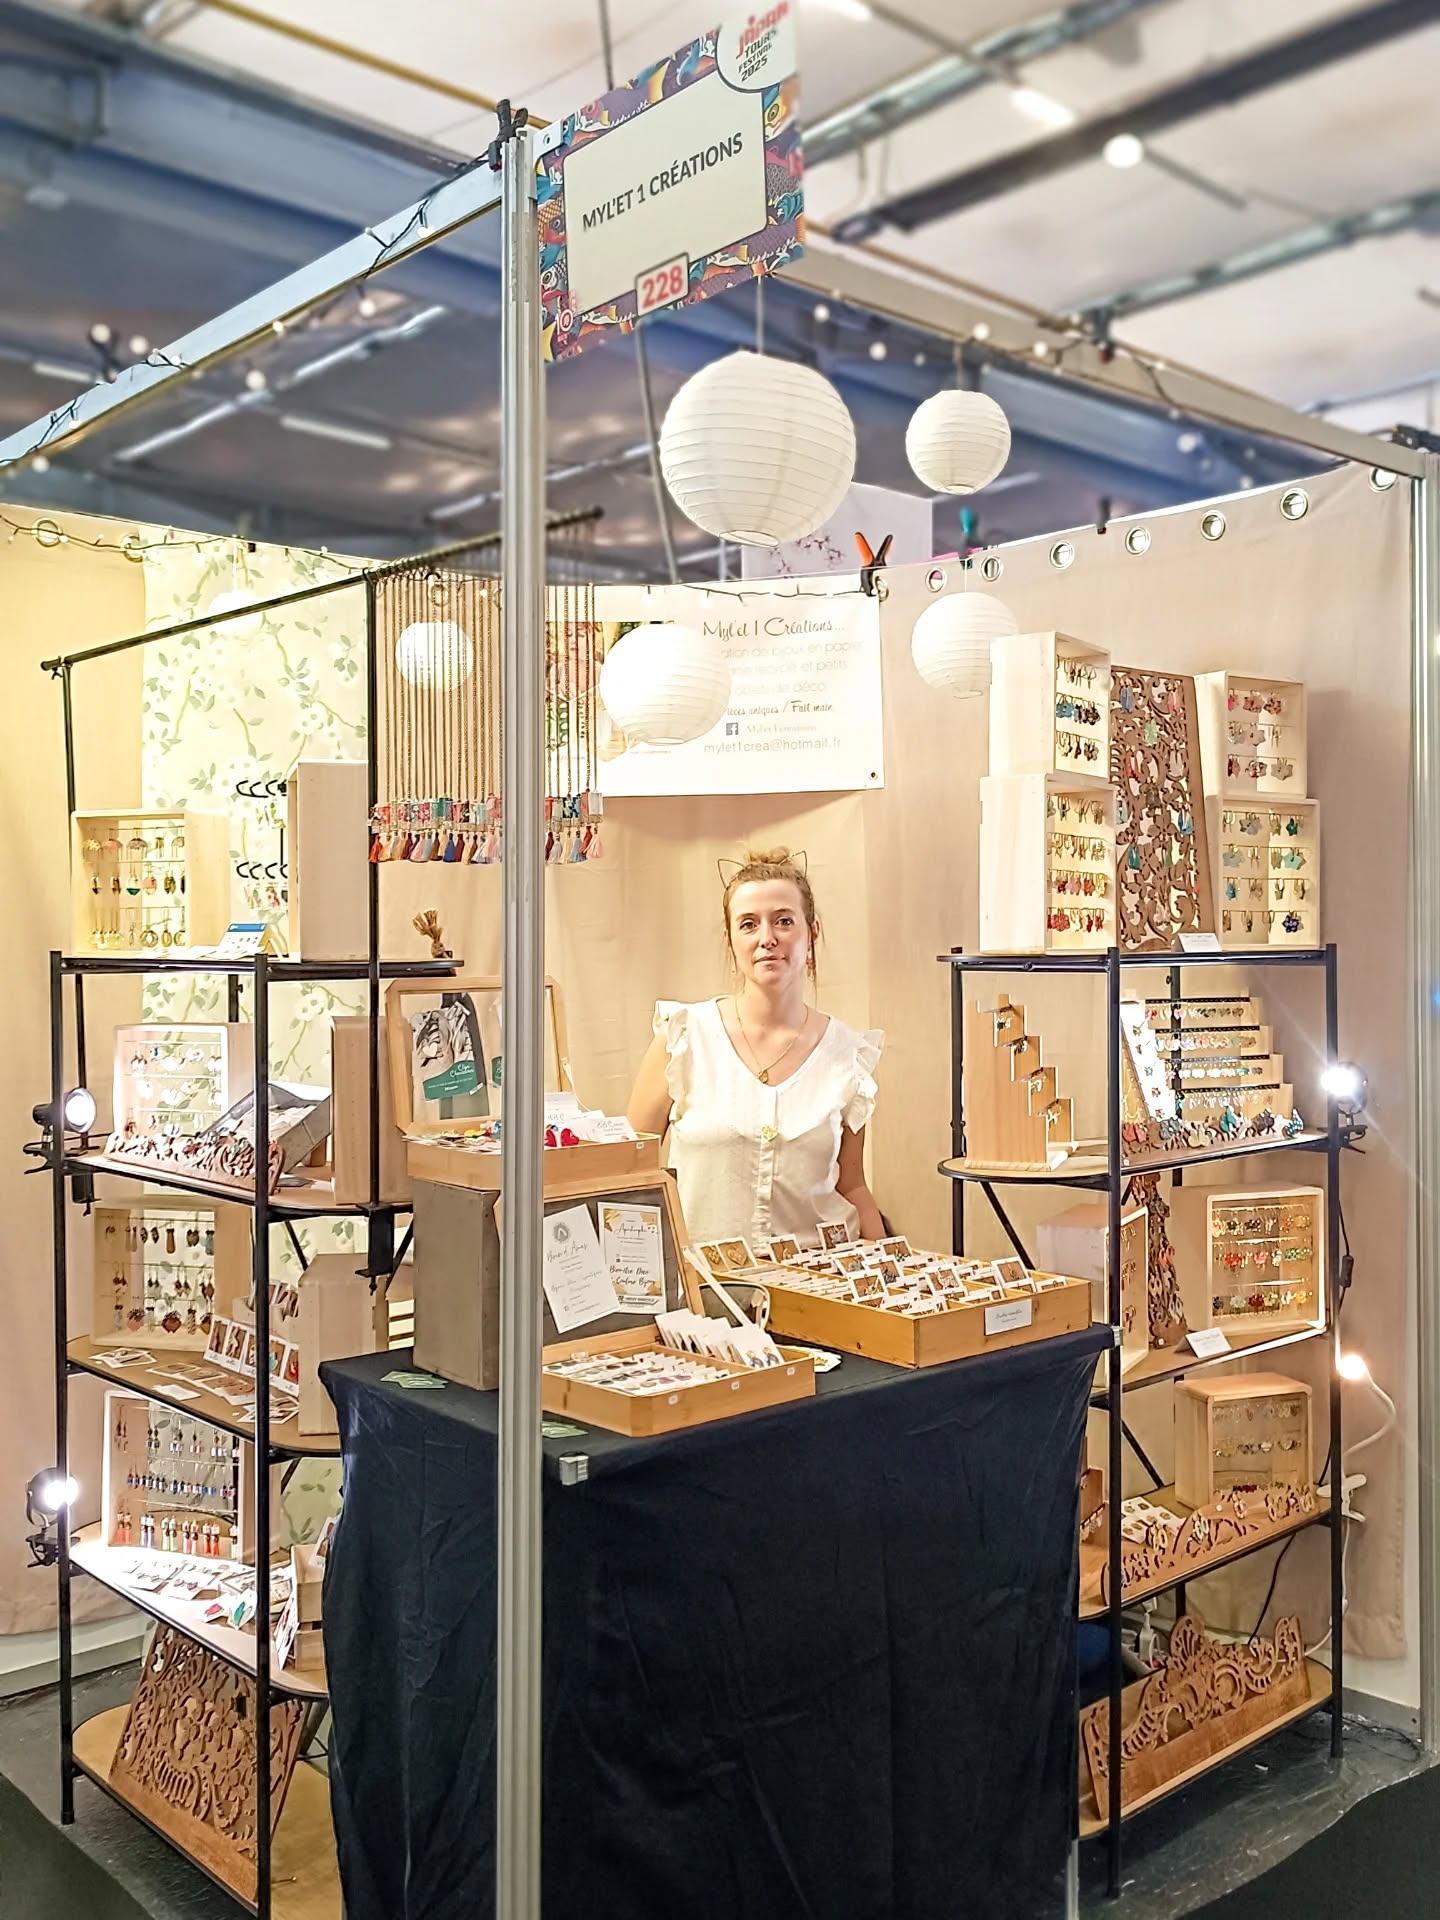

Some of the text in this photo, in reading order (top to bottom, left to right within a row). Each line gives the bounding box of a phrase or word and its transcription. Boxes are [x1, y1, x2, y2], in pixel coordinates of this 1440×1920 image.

[741, 54, 768, 83] 2025
[637, 183, 646, 205] 1
[649, 132, 743, 198] CRÉATIONS
[642, 266, 685, 310] 228
[790, 700, 811, 713] Fait
